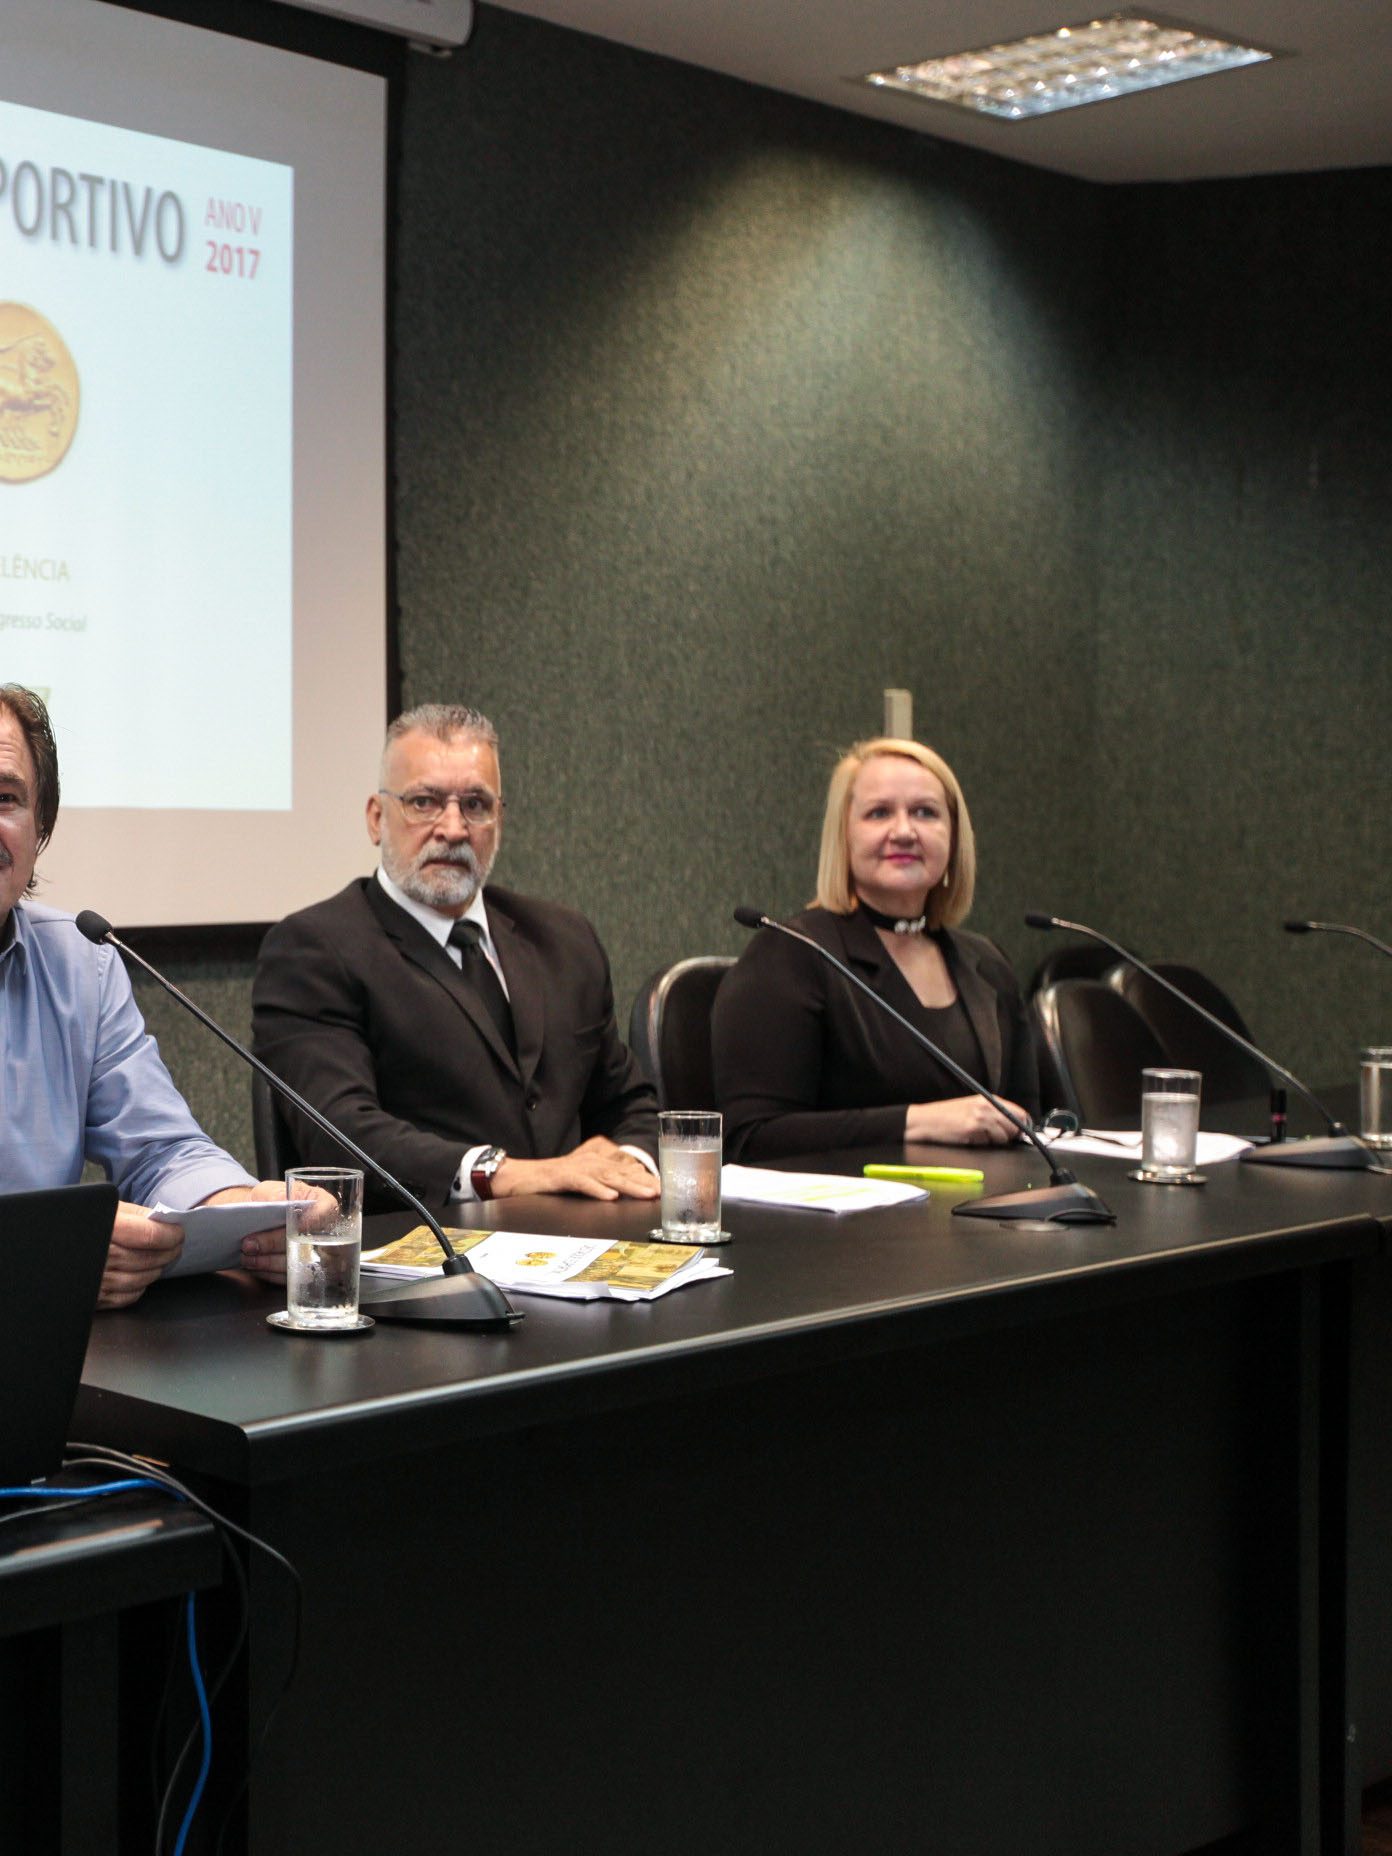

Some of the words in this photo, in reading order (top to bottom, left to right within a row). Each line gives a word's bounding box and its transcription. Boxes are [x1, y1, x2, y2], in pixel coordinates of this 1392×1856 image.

[205, 197, 245, 233] ANO
[249, 207, 262, 236] V
[205, 241, 261, 280] 2017
[45, 612, 87, 632] Social
